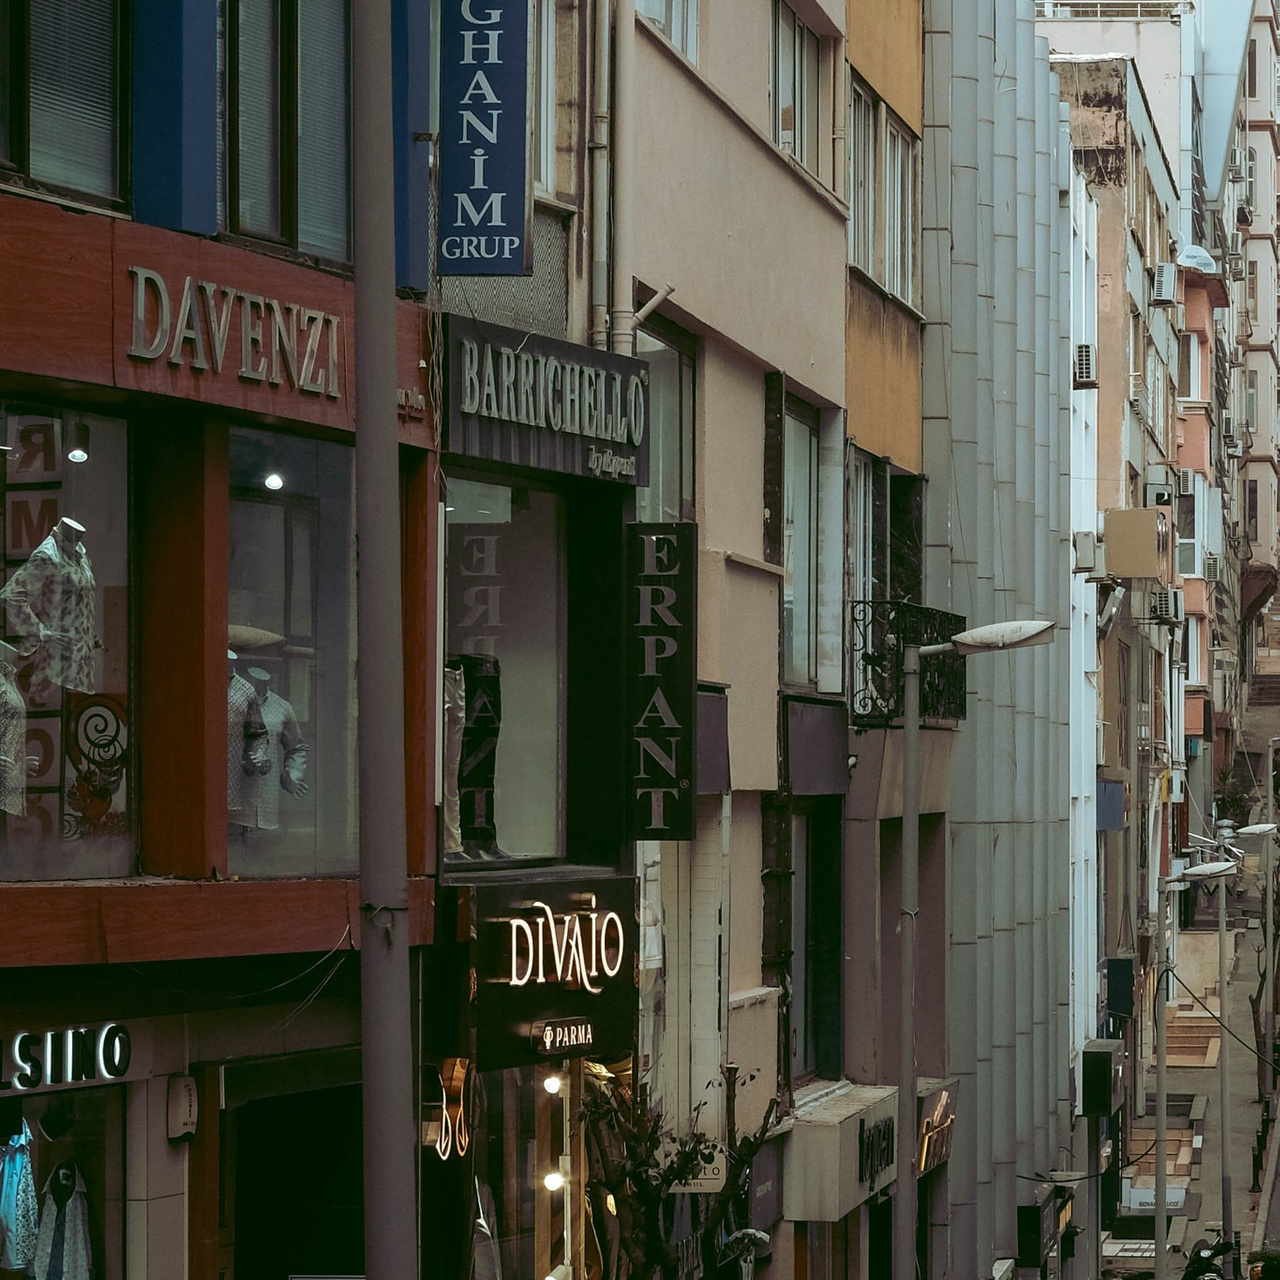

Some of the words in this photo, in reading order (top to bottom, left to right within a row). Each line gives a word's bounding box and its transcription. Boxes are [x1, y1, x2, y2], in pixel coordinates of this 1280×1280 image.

[441, 236, 520, 261] GRUP
[127, 266, 341, 399] DAVENZI
[460, 338, 645, 447] BARRICHELLO
[633, 534, 683, 830] ERPANT
[556, 1024, 593, 1048] PARMA
